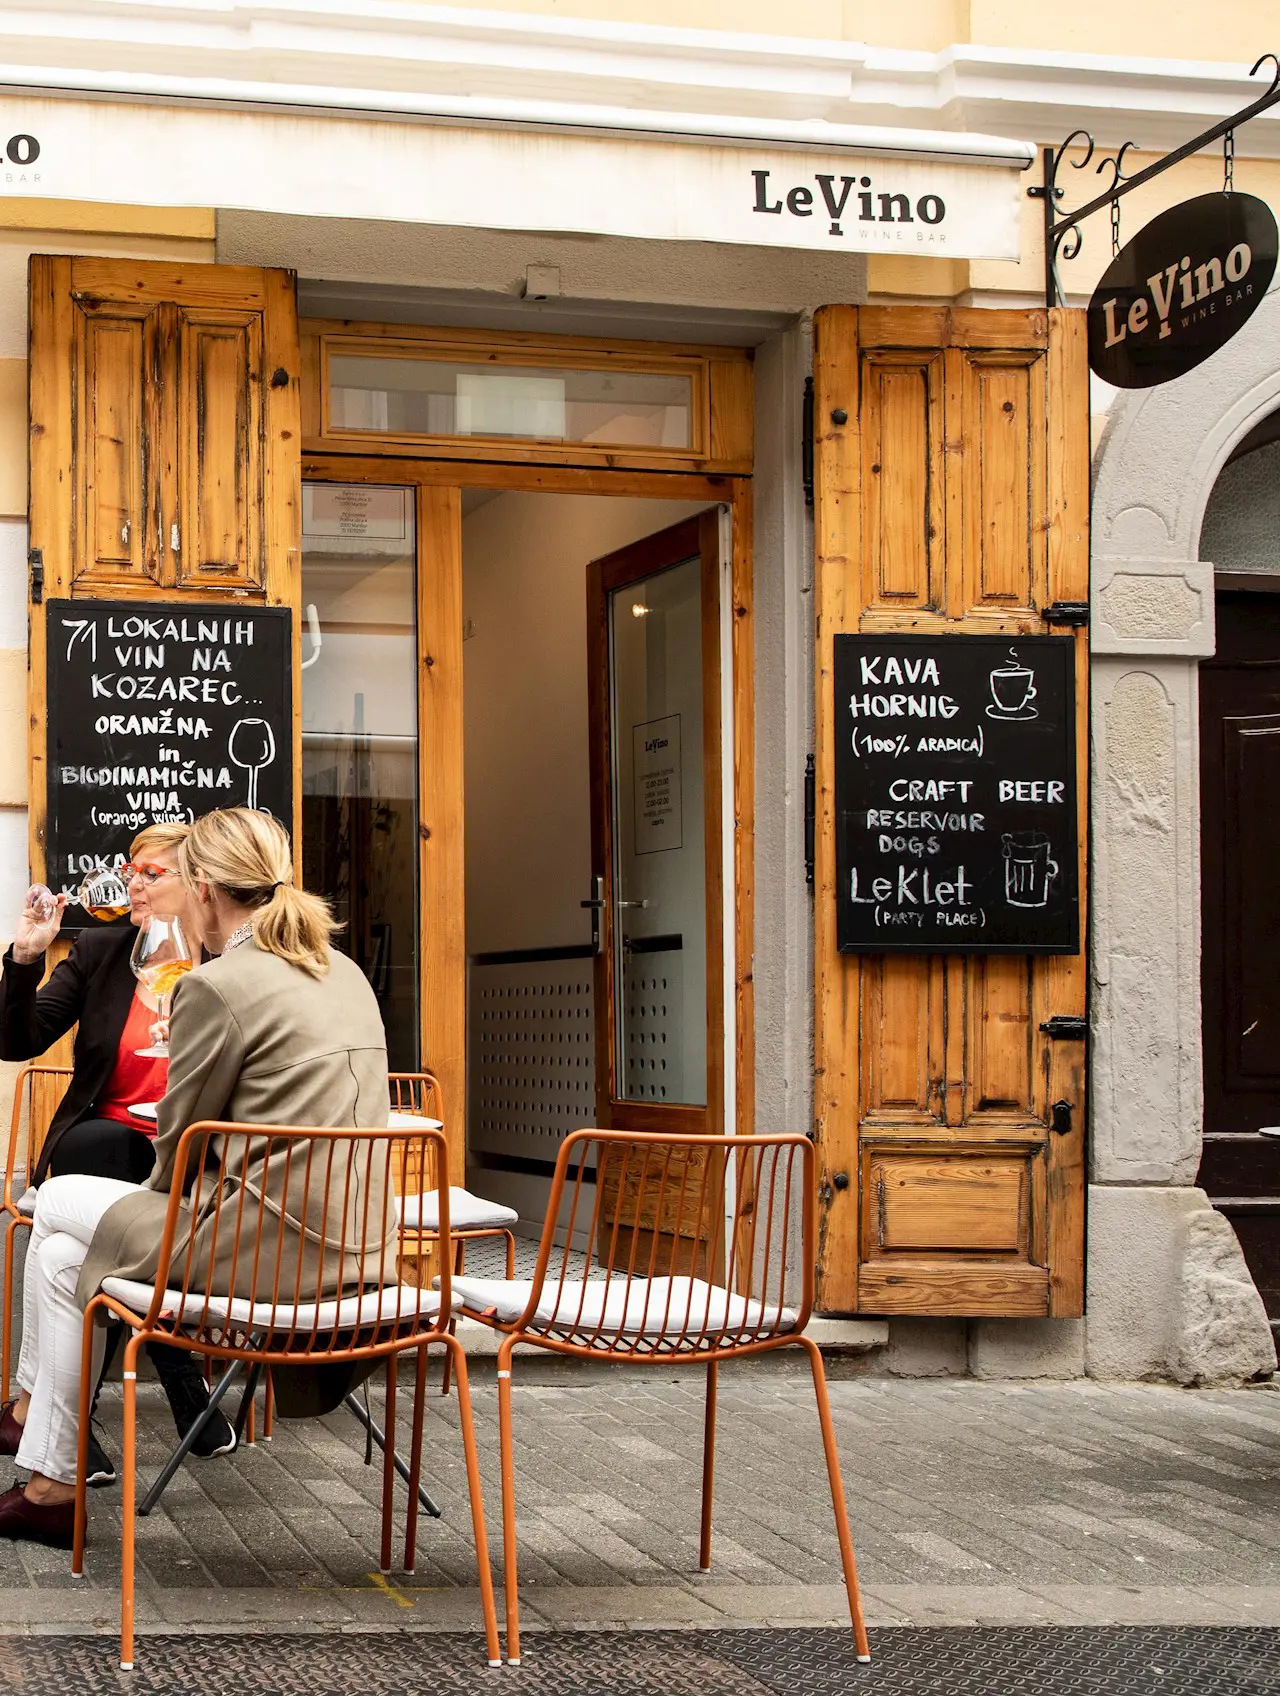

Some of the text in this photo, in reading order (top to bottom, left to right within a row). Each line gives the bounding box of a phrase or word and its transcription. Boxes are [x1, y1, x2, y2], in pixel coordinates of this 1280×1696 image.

[6, 173, 42, 183] BAR
[751, 170, 946, 235] LeVino
[859, 229, 948, 243] WINE BAR
[1103, 242, 1252, 348] LeVino
[1181, 284, 1253, 328] WINE BAR
[107, 616, 254, 646] LOKALNIH
[115, 644, 233, 673] VIN NA
[859, 656, 941, 687] KAVA
[849, 694, 960, 719] HORNIG
[95, 708, 213, 740] ORANŽNA
[158, 743, 180, 763] in
[851, 726, 911, 758] (100%
[126, 791, 182, 812] VINA
[888, 779, 1065, 804] CRAFT BEER
[91, 806, 147, 830] (orange
[866, 809, 986, 832] RESERVOIR
[878, 834, 941, 857] DOGS
[850, 865, 974, 905] LeKlet
[875, 905, 986, 928] (PARTY PLACE)
